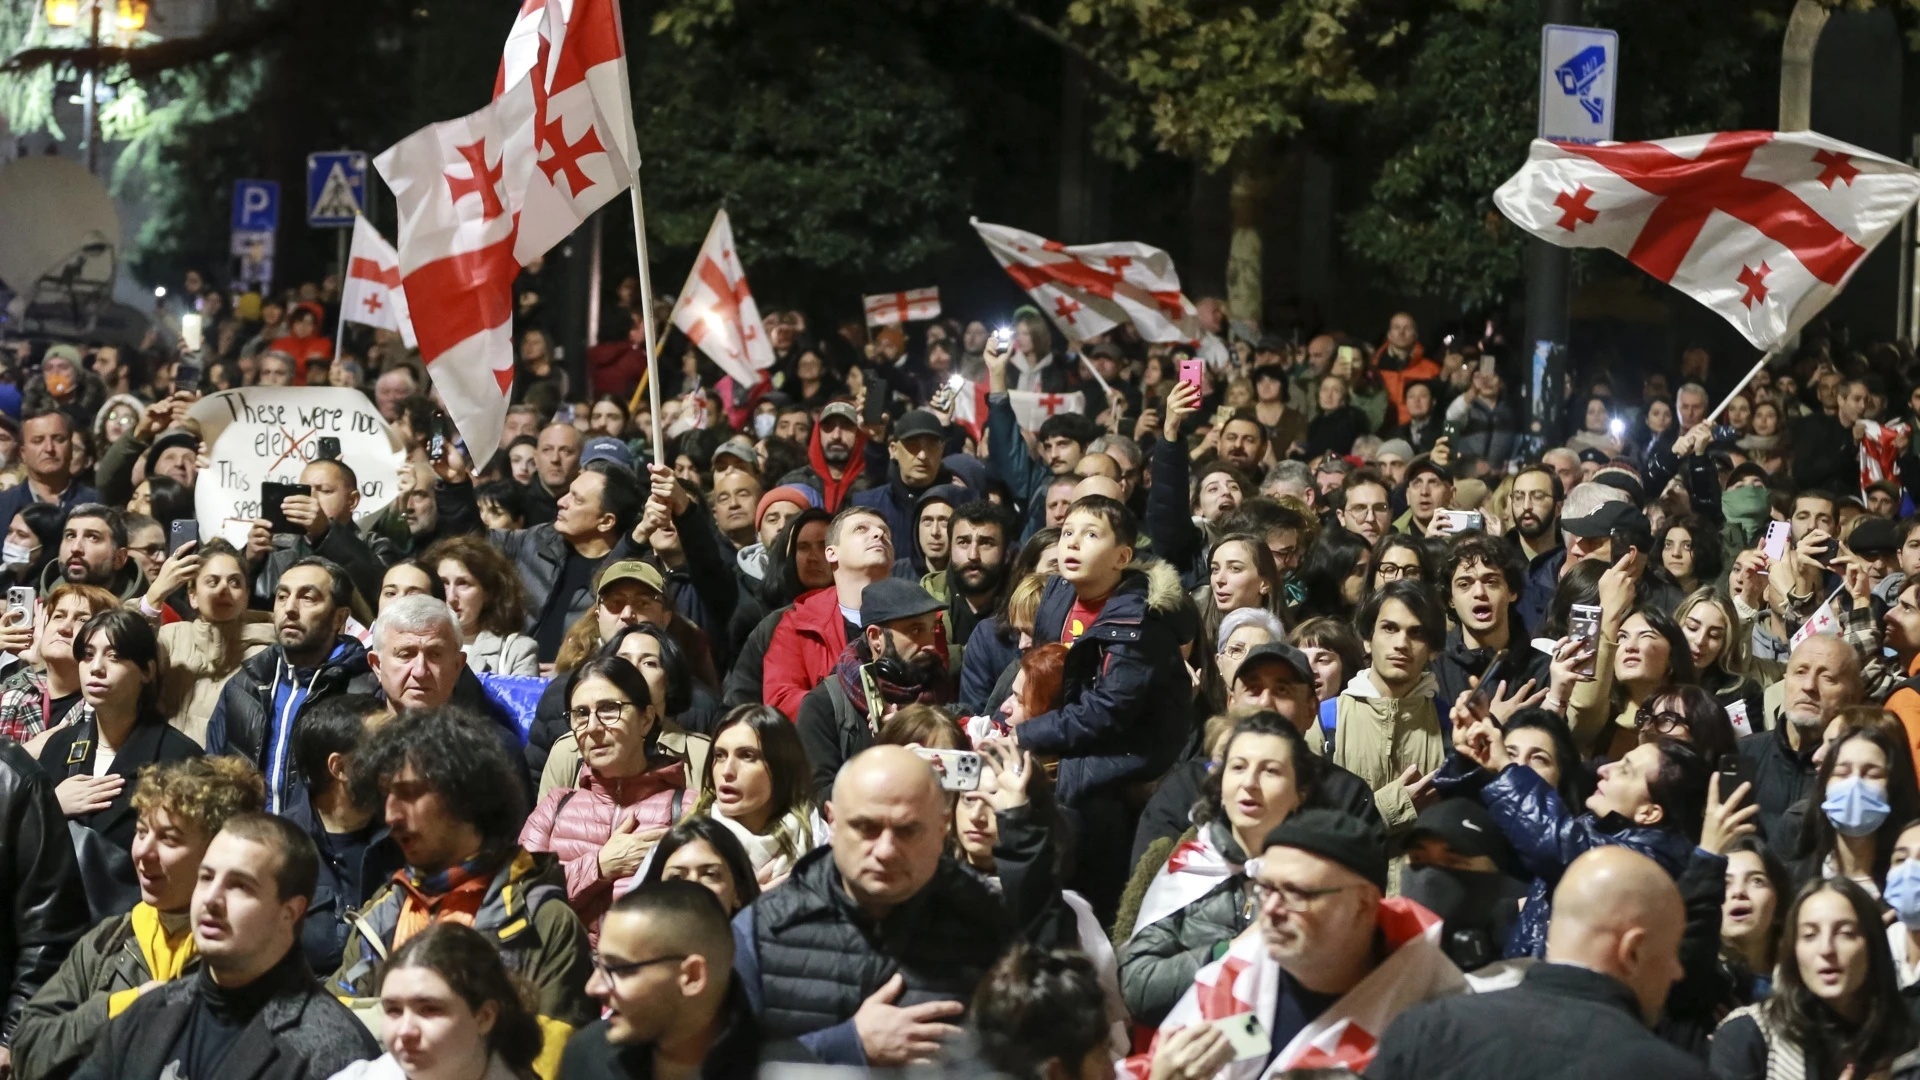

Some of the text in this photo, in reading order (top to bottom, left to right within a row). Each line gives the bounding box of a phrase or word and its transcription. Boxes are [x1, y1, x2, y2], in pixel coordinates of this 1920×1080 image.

[241, 187, 269, 225] P
[215, 392, 286, 426] These
[297, 405, 343, 432] were
[254, 427, 318, 462] electio
[217, 460, 251, 492] This
